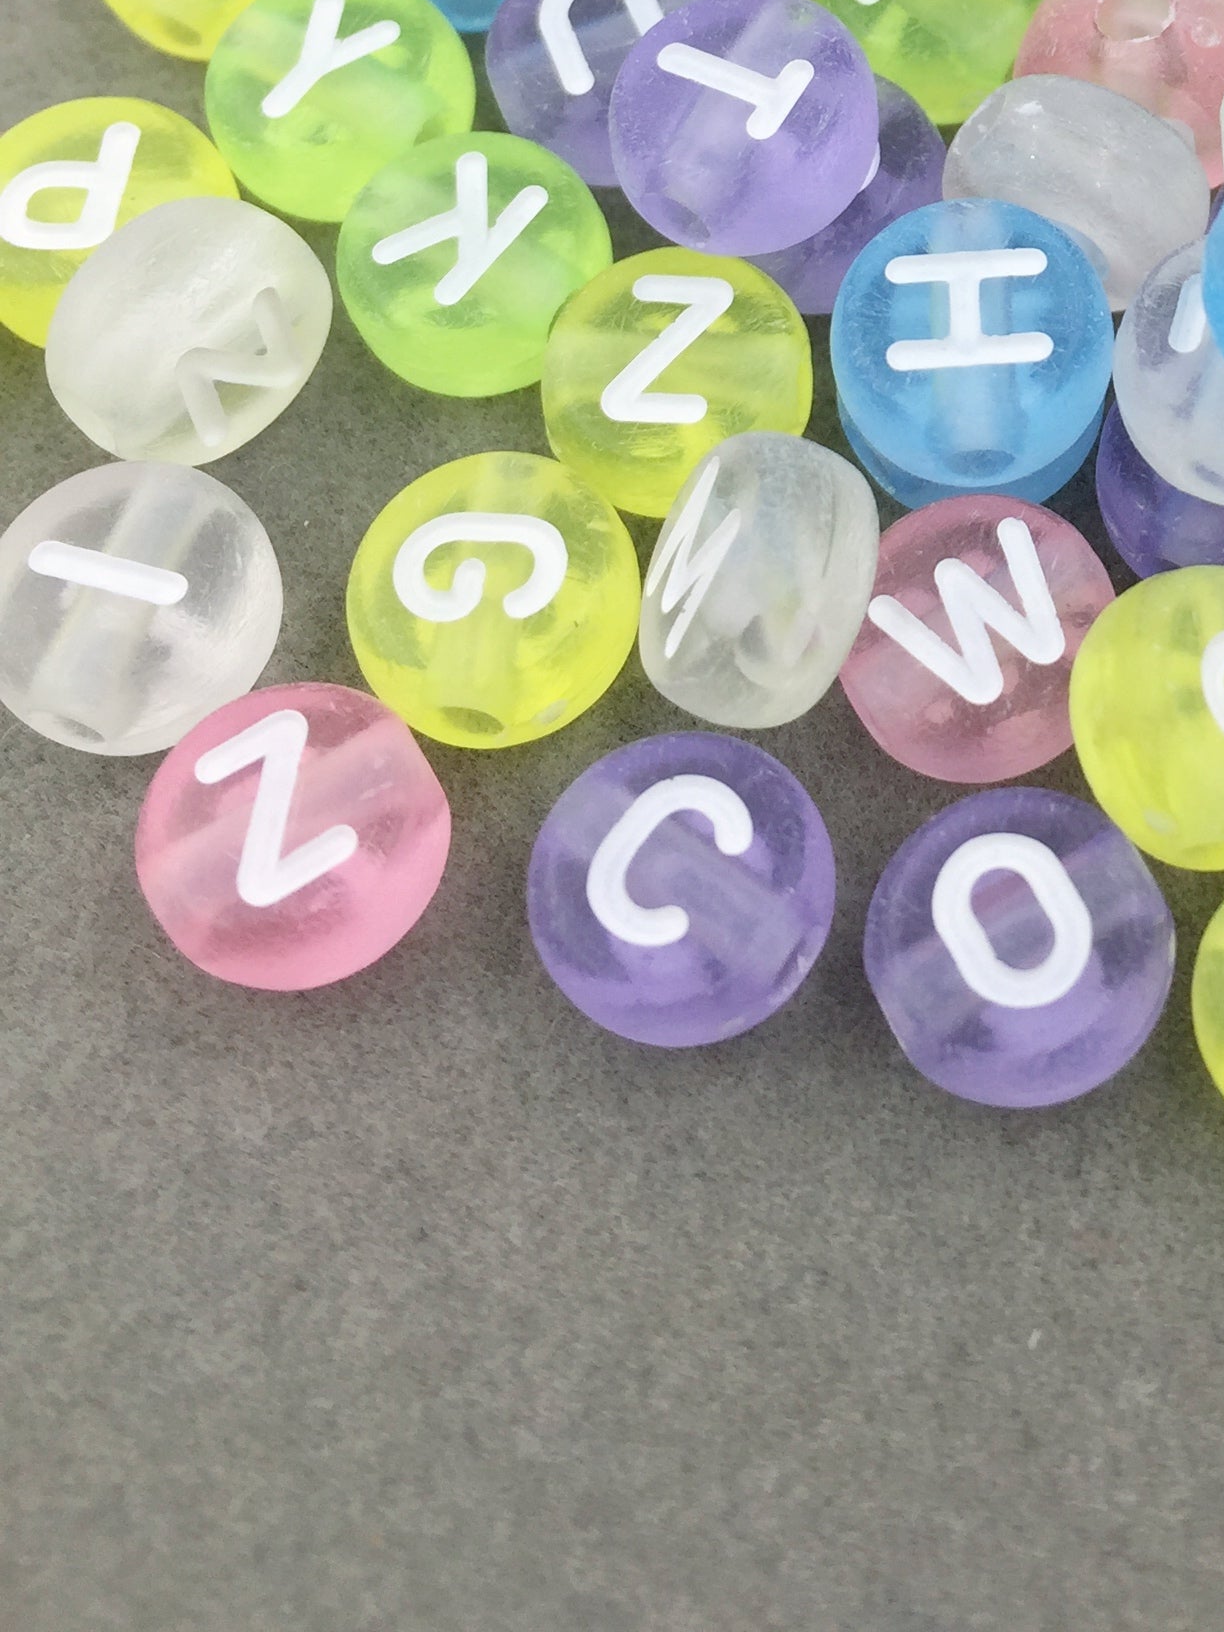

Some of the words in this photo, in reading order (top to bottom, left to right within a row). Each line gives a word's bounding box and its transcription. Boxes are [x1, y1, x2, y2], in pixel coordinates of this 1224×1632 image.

[657, 43, 814, 140] T
[0, 120, 142, 252] P
[372, 153, 547, 305] K
[601, 276, 733, 423] Z
[886, 250, 1052, 370] H
[394, 513, 567, 621] G
[868, 518, 1065, 704] W
[195, 710, 357, 906] Z
[588, 776, 752, 946] C
[933, 835, 1091, 1007] O
